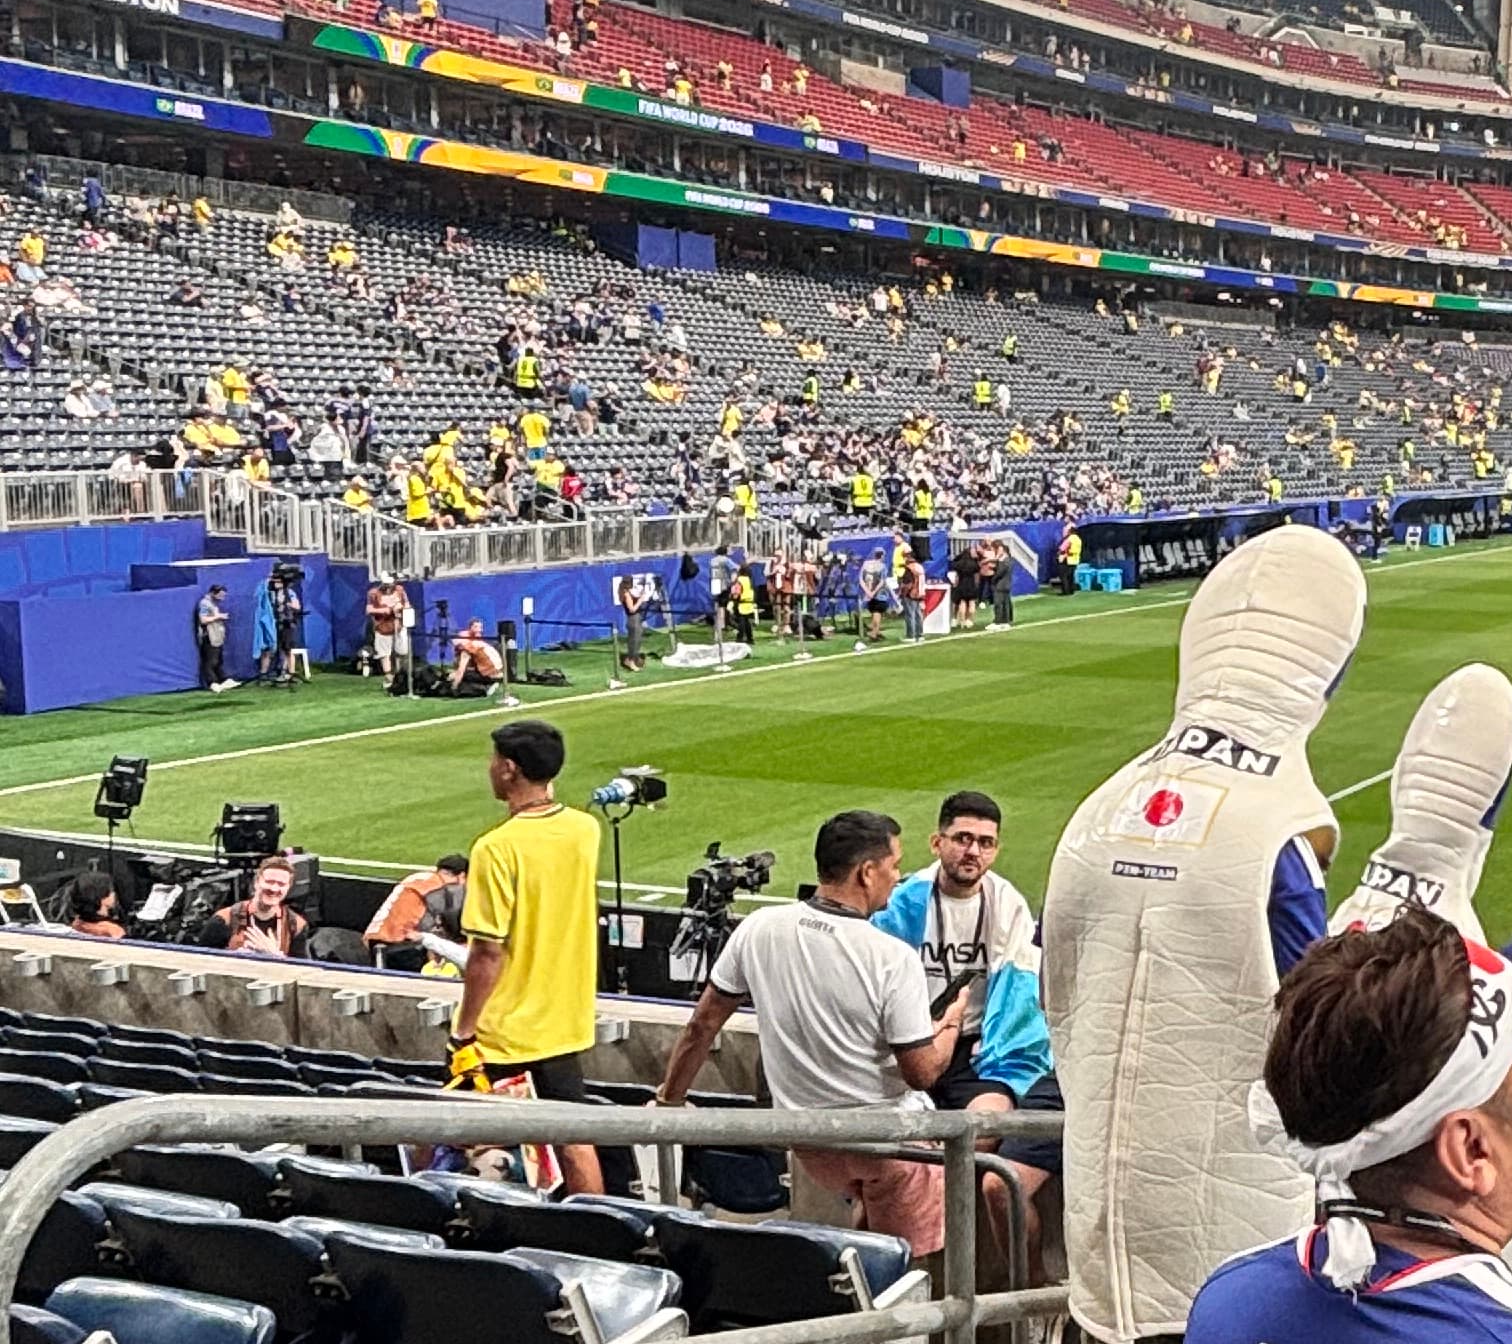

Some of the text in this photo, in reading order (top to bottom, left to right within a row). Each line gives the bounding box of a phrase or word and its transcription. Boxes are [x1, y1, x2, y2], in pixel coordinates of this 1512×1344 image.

[638, 99, 755, 137] FIFA WORLD CUP 2026
[916, 160, 980, 185] HOUSTON
[921, 942, 987, 964] NASA
